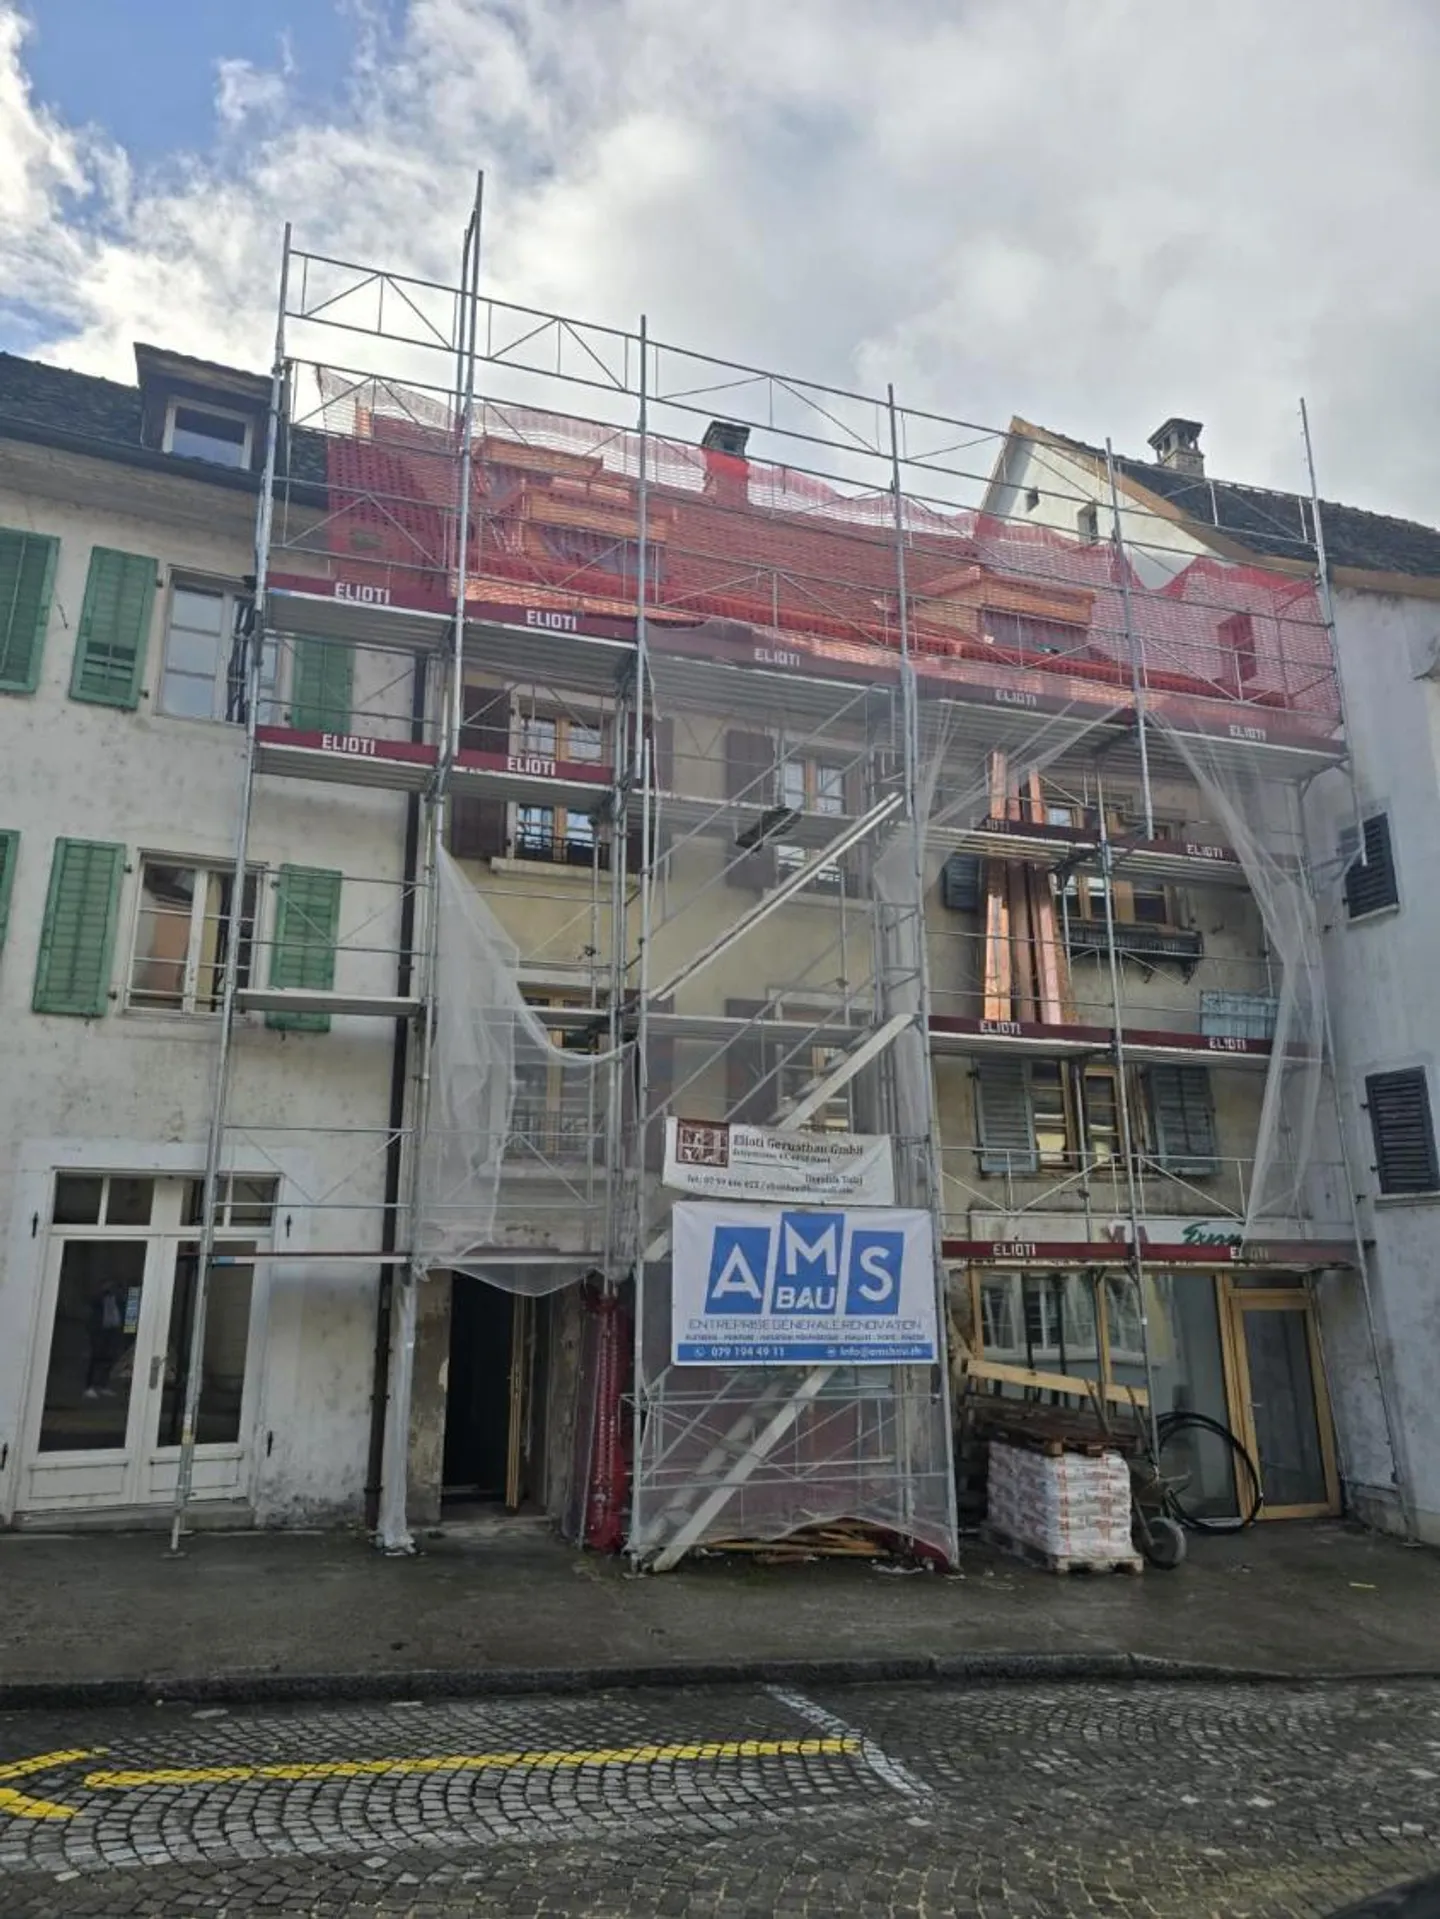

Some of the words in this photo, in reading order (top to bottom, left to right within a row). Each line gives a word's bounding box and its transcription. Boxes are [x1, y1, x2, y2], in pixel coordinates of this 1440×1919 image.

[334, 581, 391, 605] ELIOTI
[525, 609, 578, 632] ELIOTI
[754, 648, 801, 667] ELIOTI
[321, 733, 375, 755] ELIOTI
[507, 756, 556, 776] ELIOTI
[1187, 844, 1223, 859] ELIOTI
[980, 1020, 1022, 1036] ELIOTI
[1209, 1036, 1247, 1052] ELIOTI
[992, 1243, 1036, 1257] ELIOTI
[776, 1286, 835, 1310] BAU
